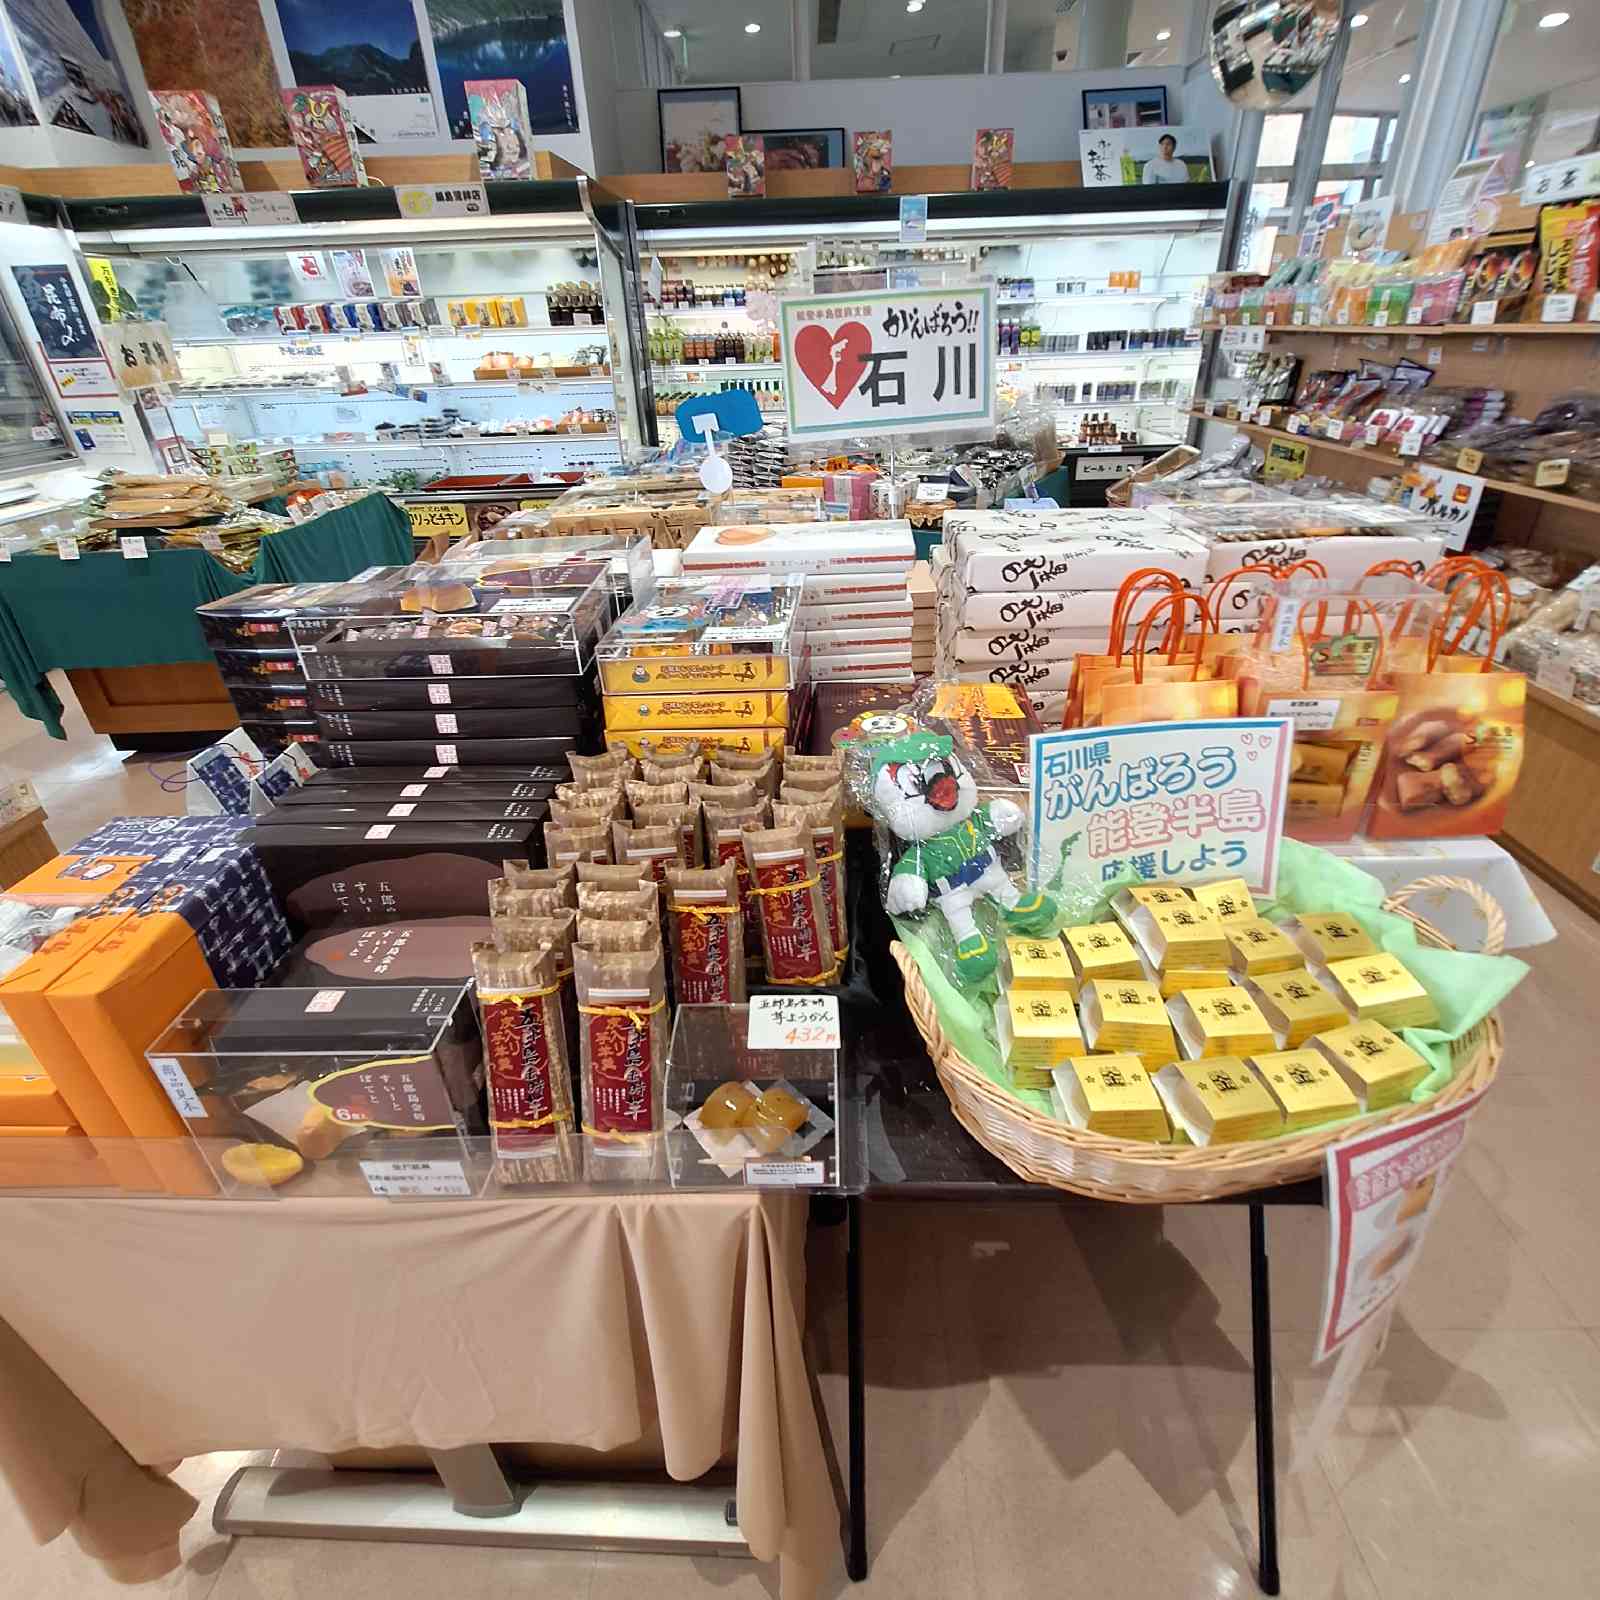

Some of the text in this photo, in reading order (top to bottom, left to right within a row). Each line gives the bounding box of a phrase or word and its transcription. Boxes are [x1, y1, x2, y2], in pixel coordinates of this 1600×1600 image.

[857, 342, 977, 408] 石川
[1044, 741, 1112, 779] 石川県
[1044, 746, 1238, 821] がんばろう
[1086, 787, 1267, 859] 能登半島
[1101, 839, 1249, 883] 応援しよう
